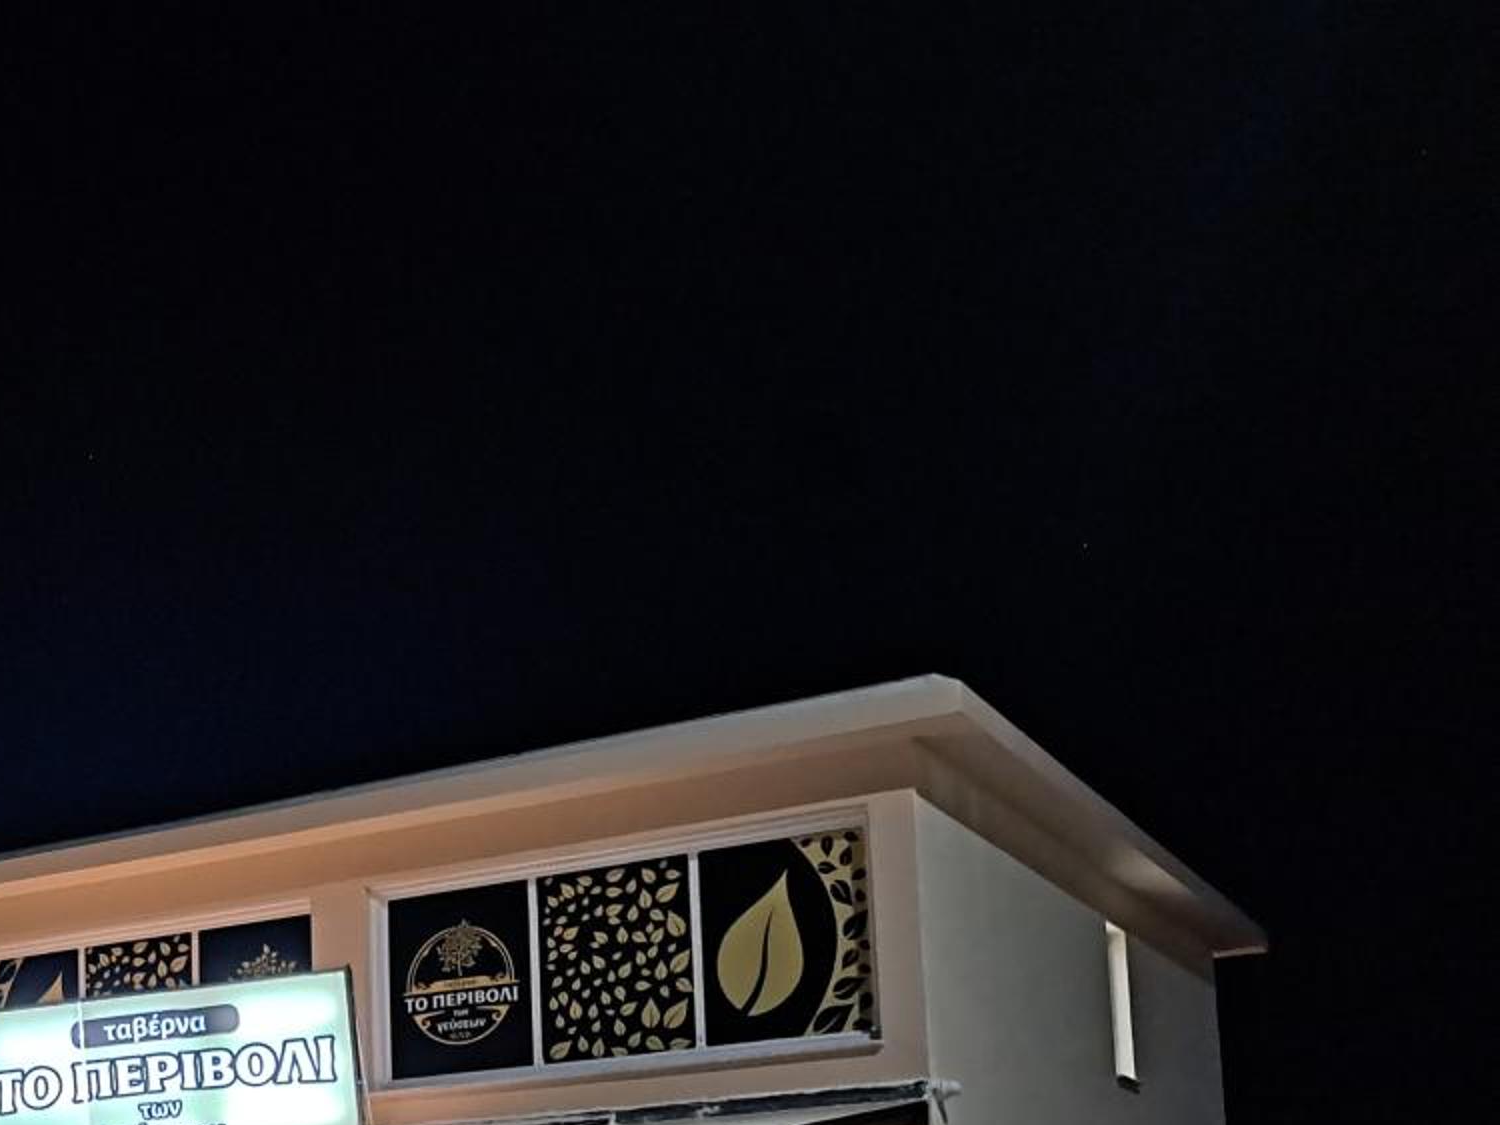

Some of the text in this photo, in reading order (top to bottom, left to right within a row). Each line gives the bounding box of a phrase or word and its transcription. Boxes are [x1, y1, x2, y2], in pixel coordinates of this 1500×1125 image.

[404, 985, 519, 1014] ΤΟ ΠΕΡΙΒΟΛΙ
[103, 1014, 206, 1043] ταβέρνα
[71, 1036, 338, 1104] ΠΕΡΙΒΟΛΙ
[138, 1100, 182, 1119] των
